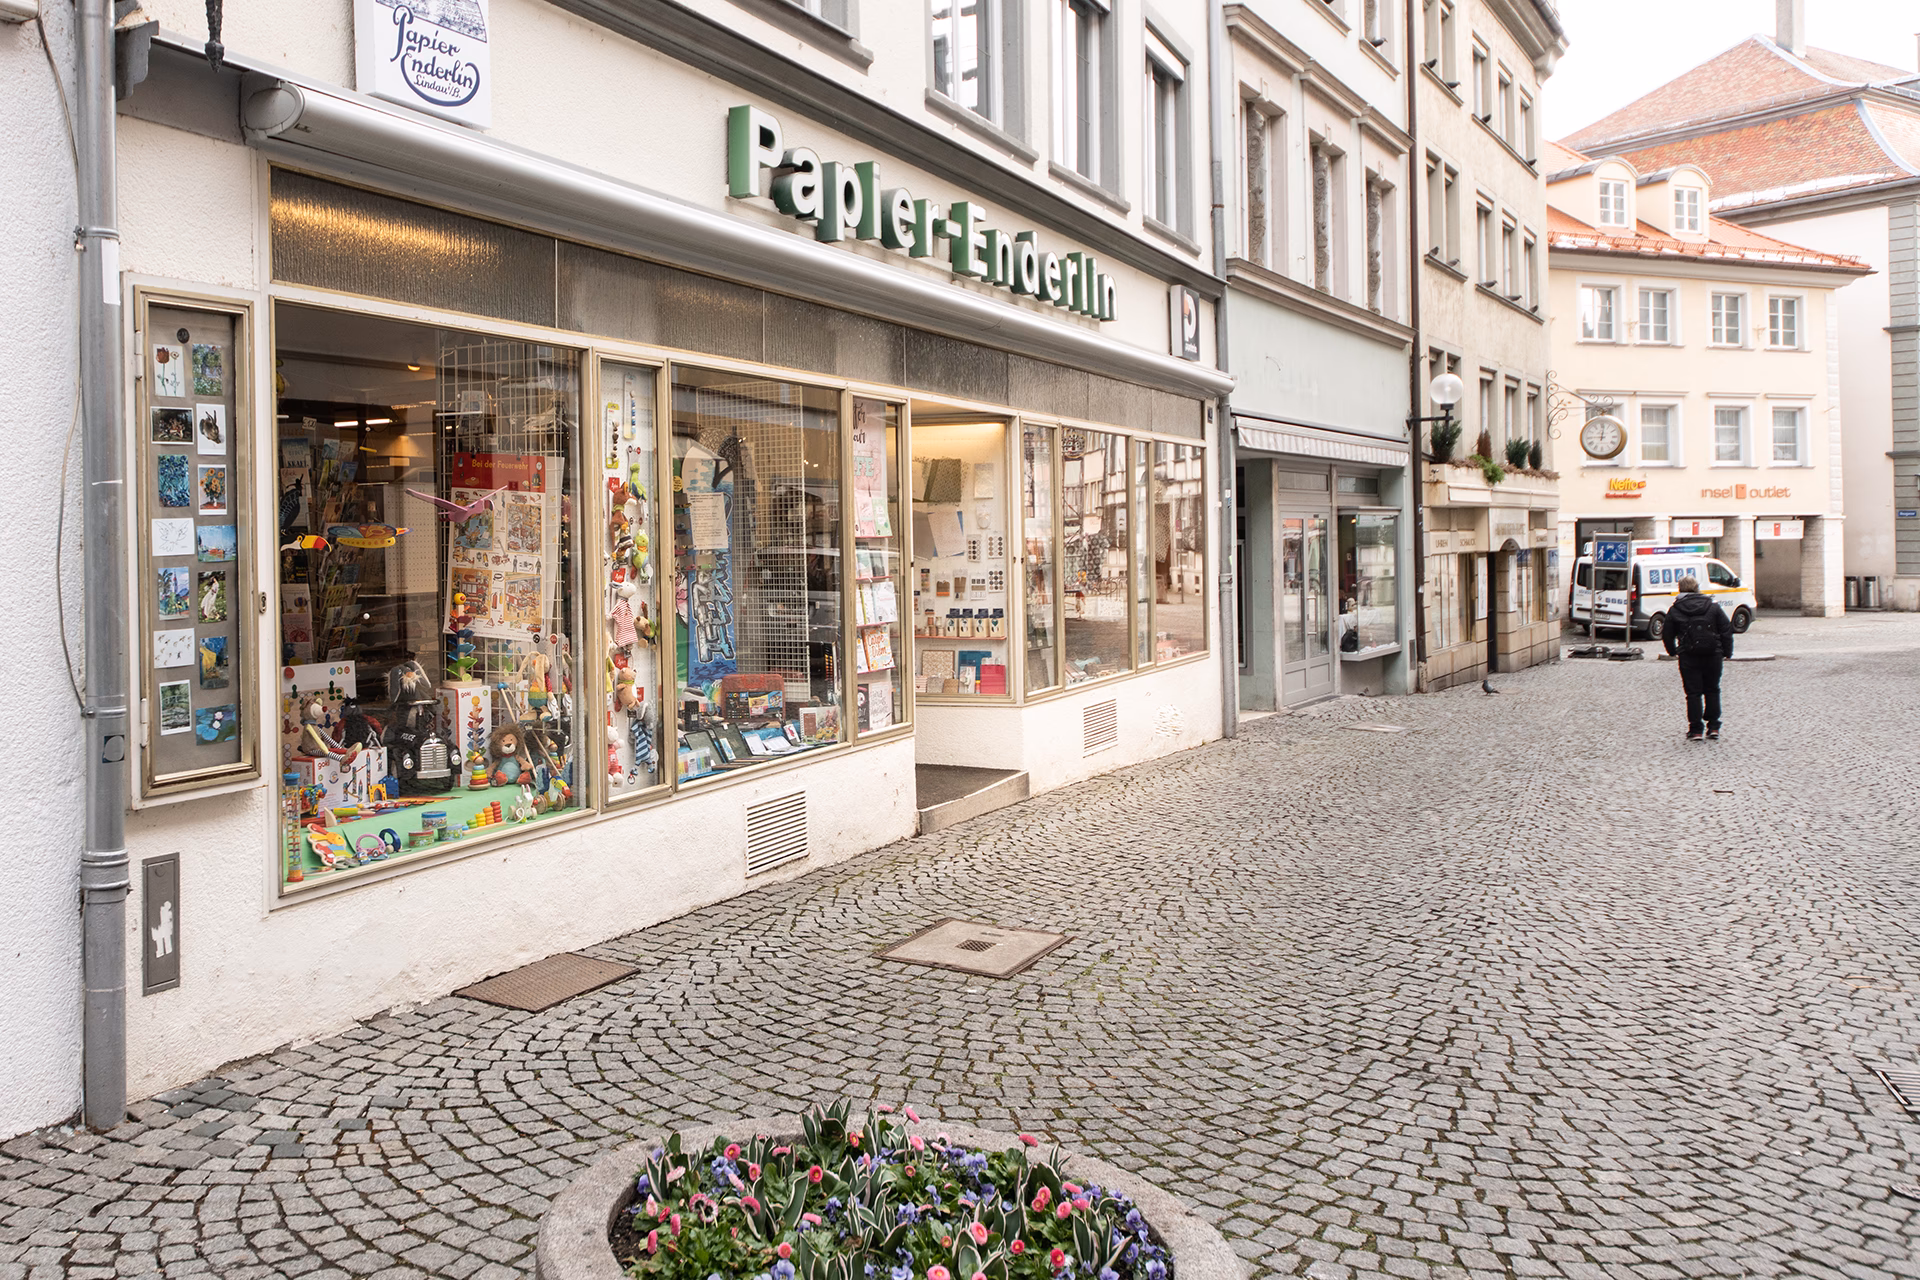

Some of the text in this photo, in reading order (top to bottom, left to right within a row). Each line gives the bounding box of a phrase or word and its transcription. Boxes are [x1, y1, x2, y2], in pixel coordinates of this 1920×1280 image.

[390, 4, 461, 62] Papier
[400, 45, 480, 106] Enderlin
[729, 104, 1118, 321] Papier-Enderlin
[471, 459, 529, 470] Bei der Feuerwehr
[1609, 478, 1639, 491] Netto
[1701, 485, 1792, 499] insel outlet
[400, 732, 416, 742] POLICE
[317, 759, 331, 770] goki
